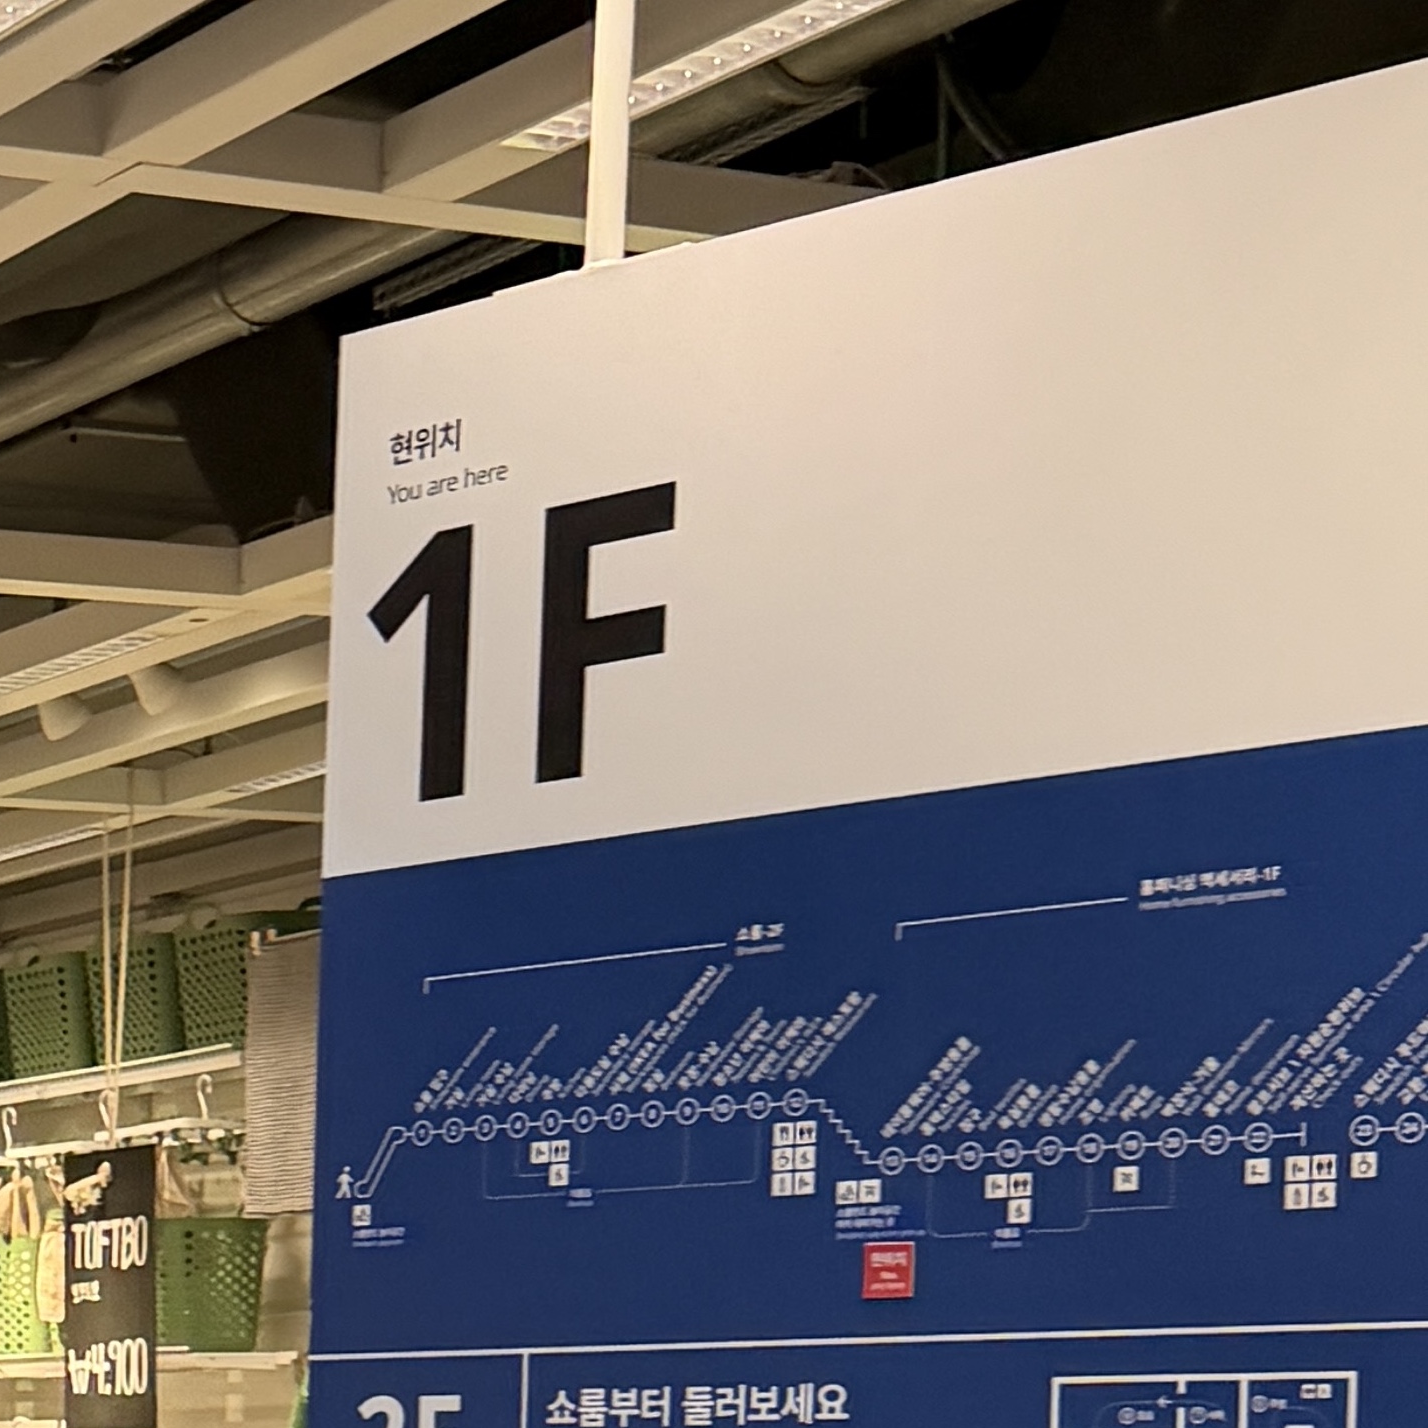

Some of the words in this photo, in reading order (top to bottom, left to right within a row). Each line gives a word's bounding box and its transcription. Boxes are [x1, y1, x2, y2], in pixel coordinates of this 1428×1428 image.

[388, 417, 463, 466] 현위치
[387, 482, 422, 505] You
[426, 474, 459, 498] are
[463, 461, 509, 487] here
[366, 480, 677, 803] 1F
[70, 1215, 148, 1270] TOFTBO
[544, 1385, 672, 1428] 쇼룸부터
[680, 1382, 851, 1428] 둘러보세요
